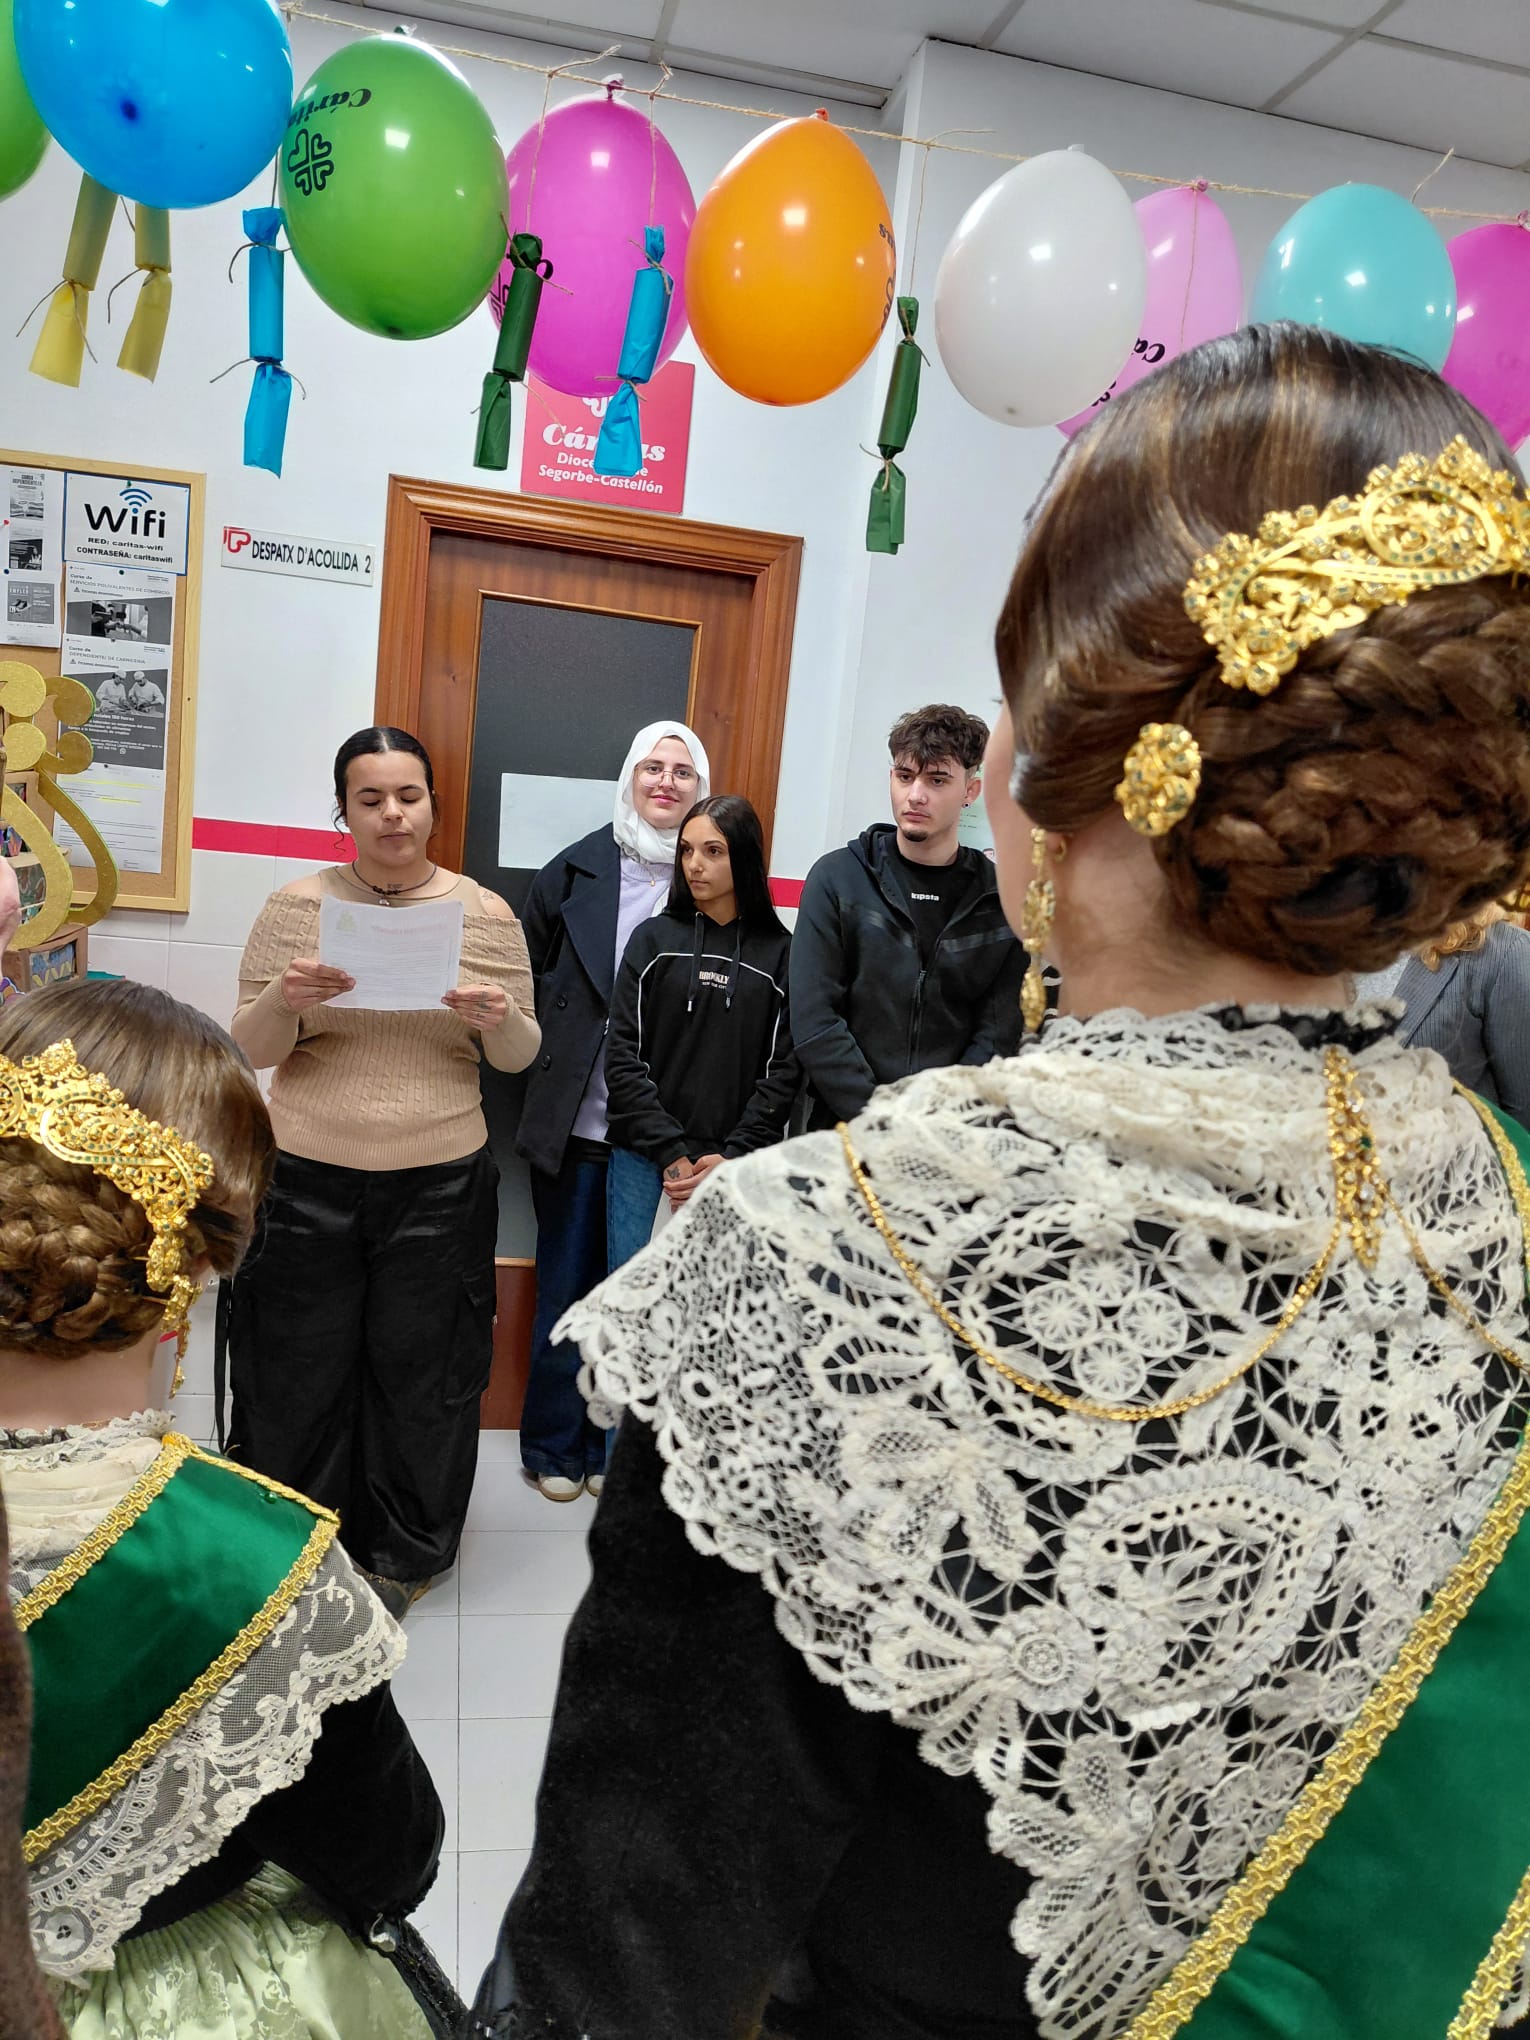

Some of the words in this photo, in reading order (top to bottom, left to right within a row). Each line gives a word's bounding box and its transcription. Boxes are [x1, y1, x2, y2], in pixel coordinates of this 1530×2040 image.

[542, 423, 666, 462] Cárs
[538, 464, 664, 495] Segorbe-Castellón
[84, 503, 166, 539] Wifi
[76, 546, 132, 559] CONTRASEÑA:
[133, 553, 173, 564] caritaswifi
[87, 537, 110, 546] RED:
[112, 541, 164, 552] caritas-wifi
[251, 540, 295, 564] DESPATX
[297, 546, 359, 573] D'ACOLLIDA
[364, 554, 372, 574] 2
[699, 970, 730, 985] BROOKLY
